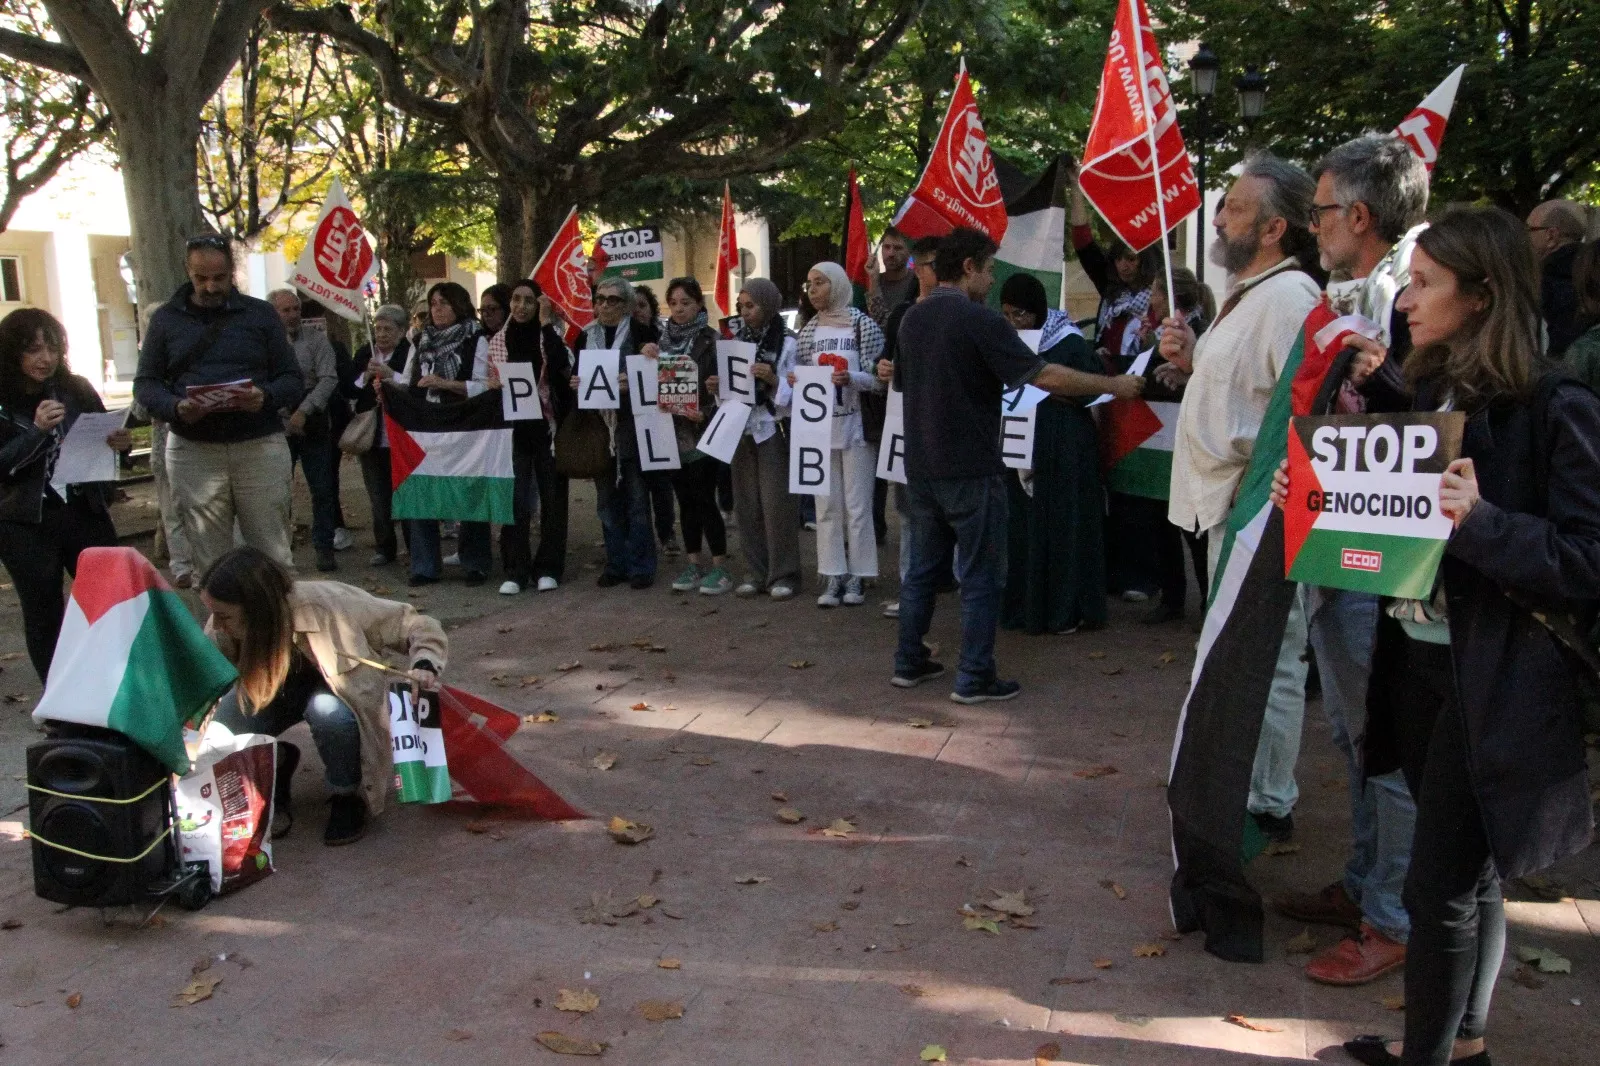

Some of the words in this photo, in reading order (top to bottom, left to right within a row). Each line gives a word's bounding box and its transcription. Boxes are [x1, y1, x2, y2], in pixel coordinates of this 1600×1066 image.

[601, 229, 653, 249] STOP
[584, 365, 616, 401] A
[637, 371, 658, 406] L
[660, 383, 698, 394] STOP
[728, 356, 750, 396] E
[508, 378, 533, 412] P
[660, 394, 697, 404] GENOCIDIO
[800, 382, 827, 423] S
[645, 429, 671, 463] L
[1001, 415, 1028, 460] E
[1310, 424, 1438, 474] STOP
[799, 447, 825, 487] B
[1306, 490, 1432, 520] GENOCIDIO
[1343, 552, 1380, 568] CCOO
